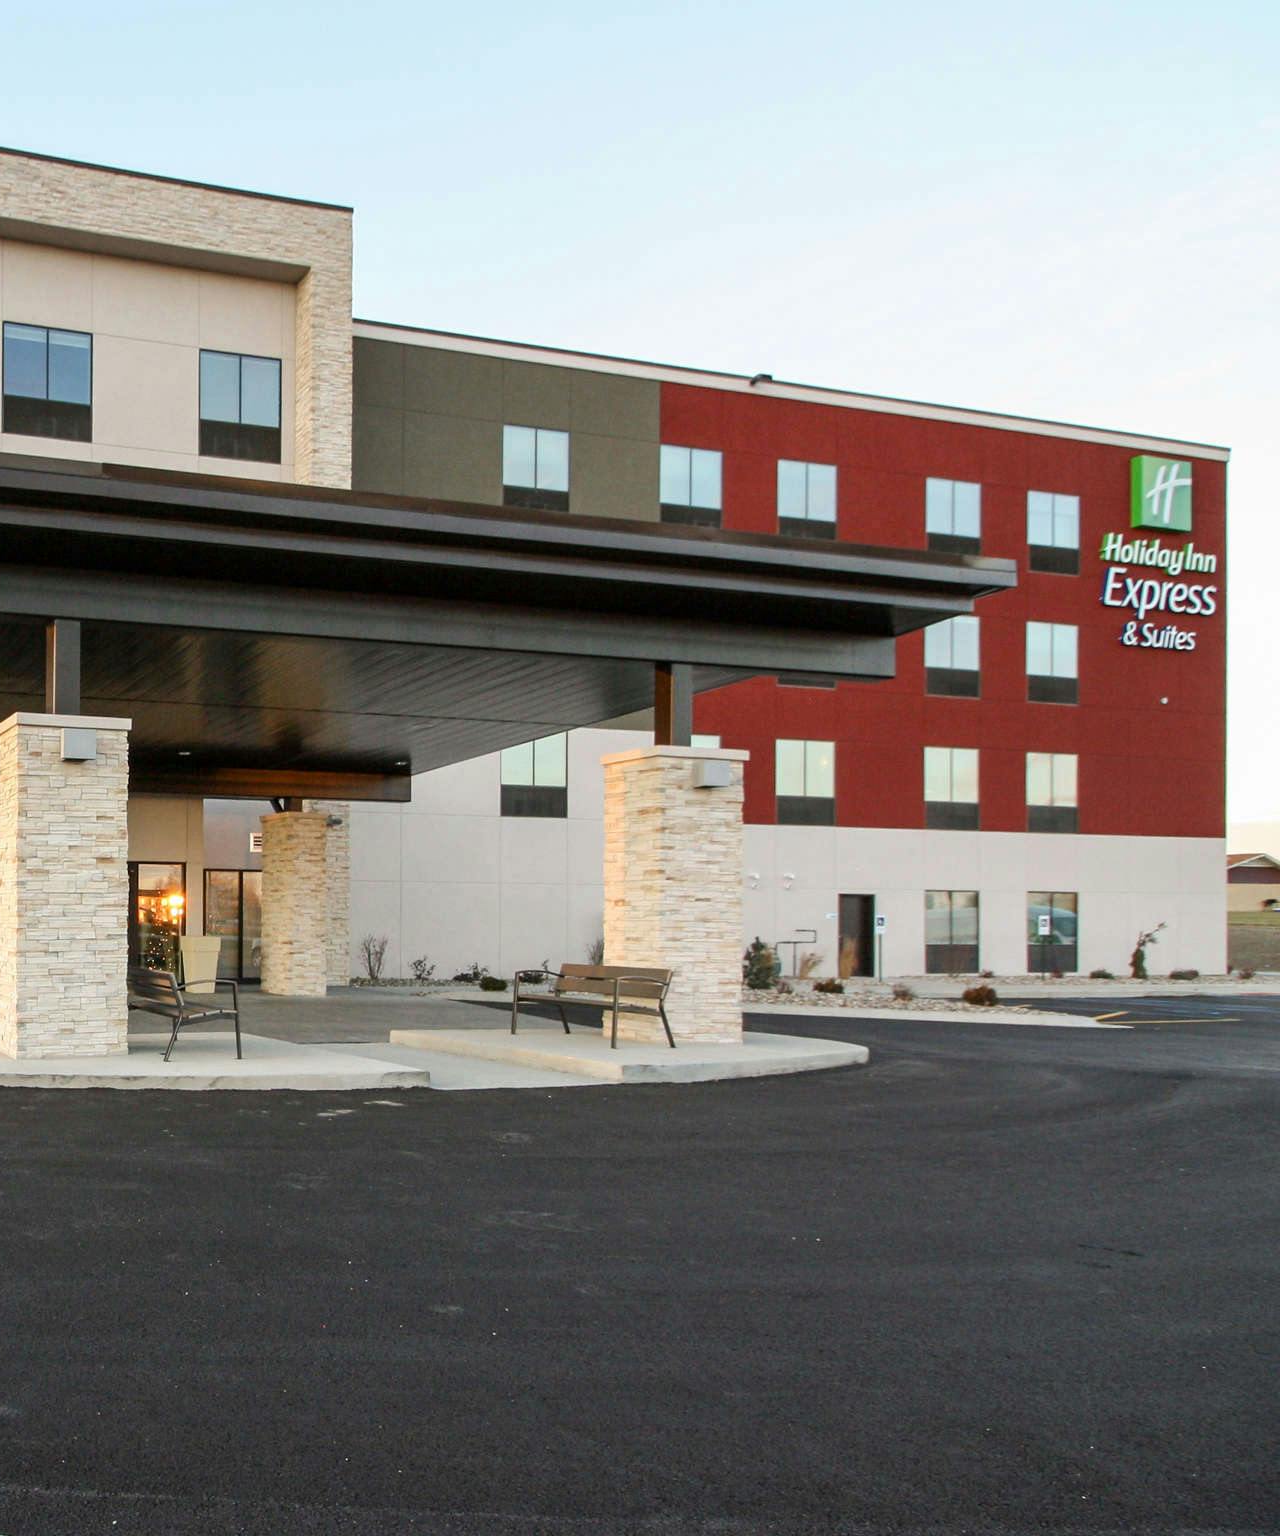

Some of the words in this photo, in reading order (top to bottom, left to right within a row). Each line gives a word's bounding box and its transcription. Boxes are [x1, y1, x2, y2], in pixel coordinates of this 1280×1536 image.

[1102, 532, 1184, 576] Holiday
[1183, 542, 1217, 573] Inn
[1103, 566, 1217, 620] Express
[1122, 621, 1139, 646] &
[1140, 622, 1197, 650] Suites
